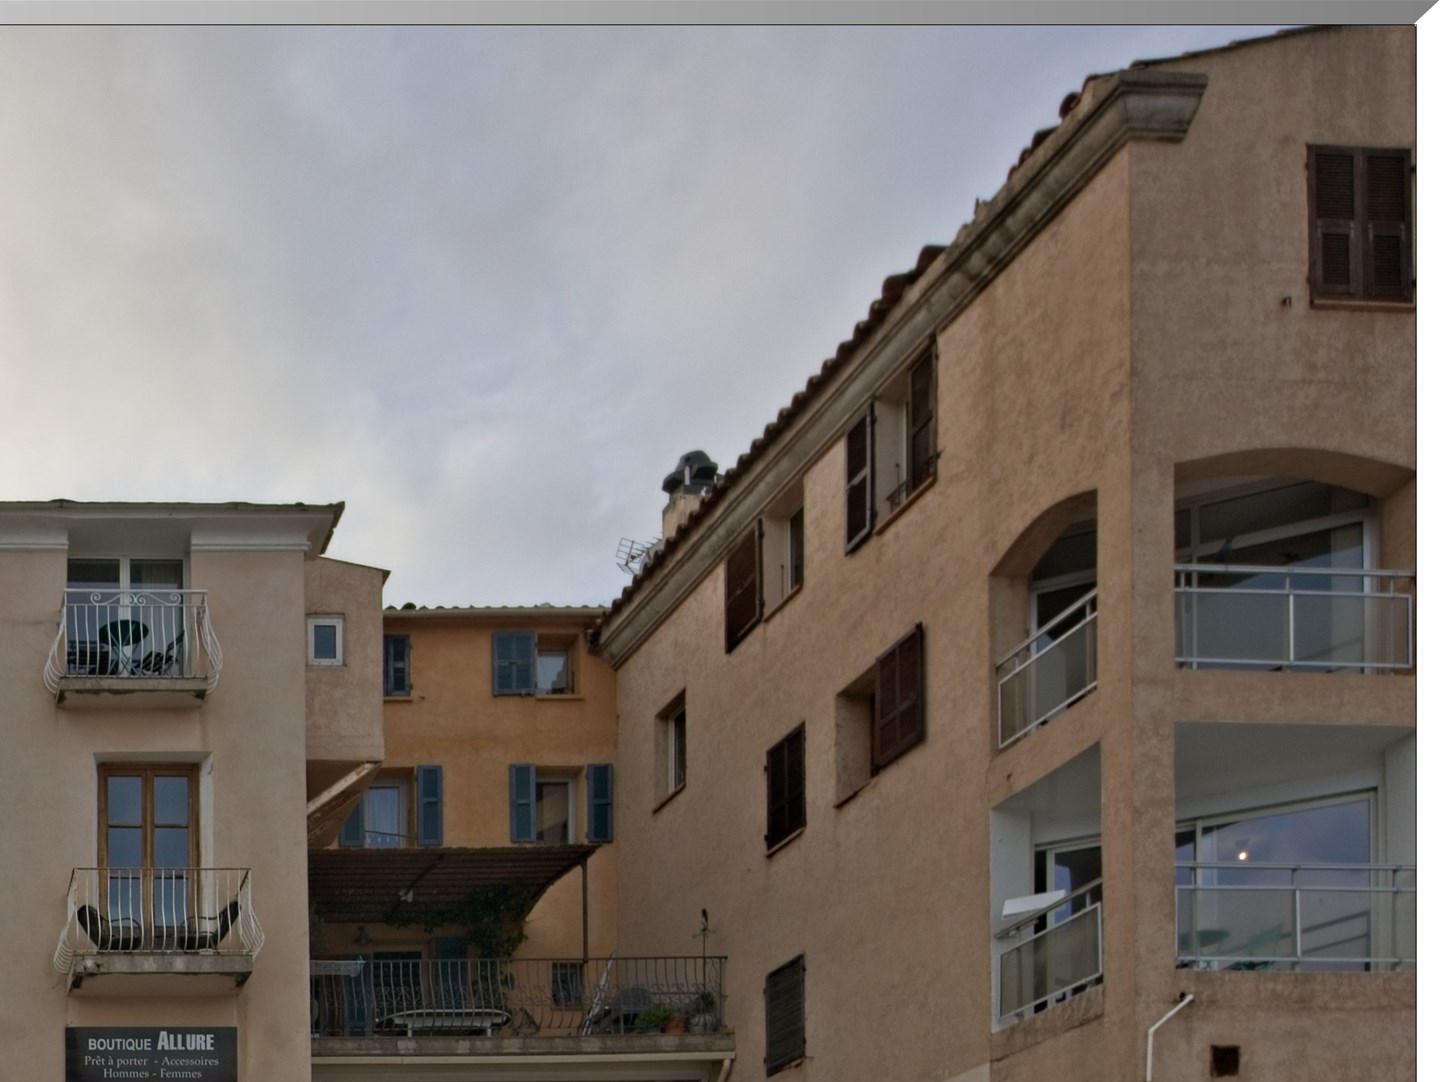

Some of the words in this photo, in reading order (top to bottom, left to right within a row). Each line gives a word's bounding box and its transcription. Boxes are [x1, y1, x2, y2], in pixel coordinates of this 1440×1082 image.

[88, 1038, 152, 1051] BOUTIQUE
[157, 1031, 214, 1051] ALLURE
[84, 1056, 105, 1066] Prêt
[107, 1056, 114, 1066] à
[116, 1057, 148, 1069] porter
[161, 1056, 219, 1067] Accessoires
[103, 1068, 150, 1079] Hommes
[160, 1068, 202, 1079] Femmes
